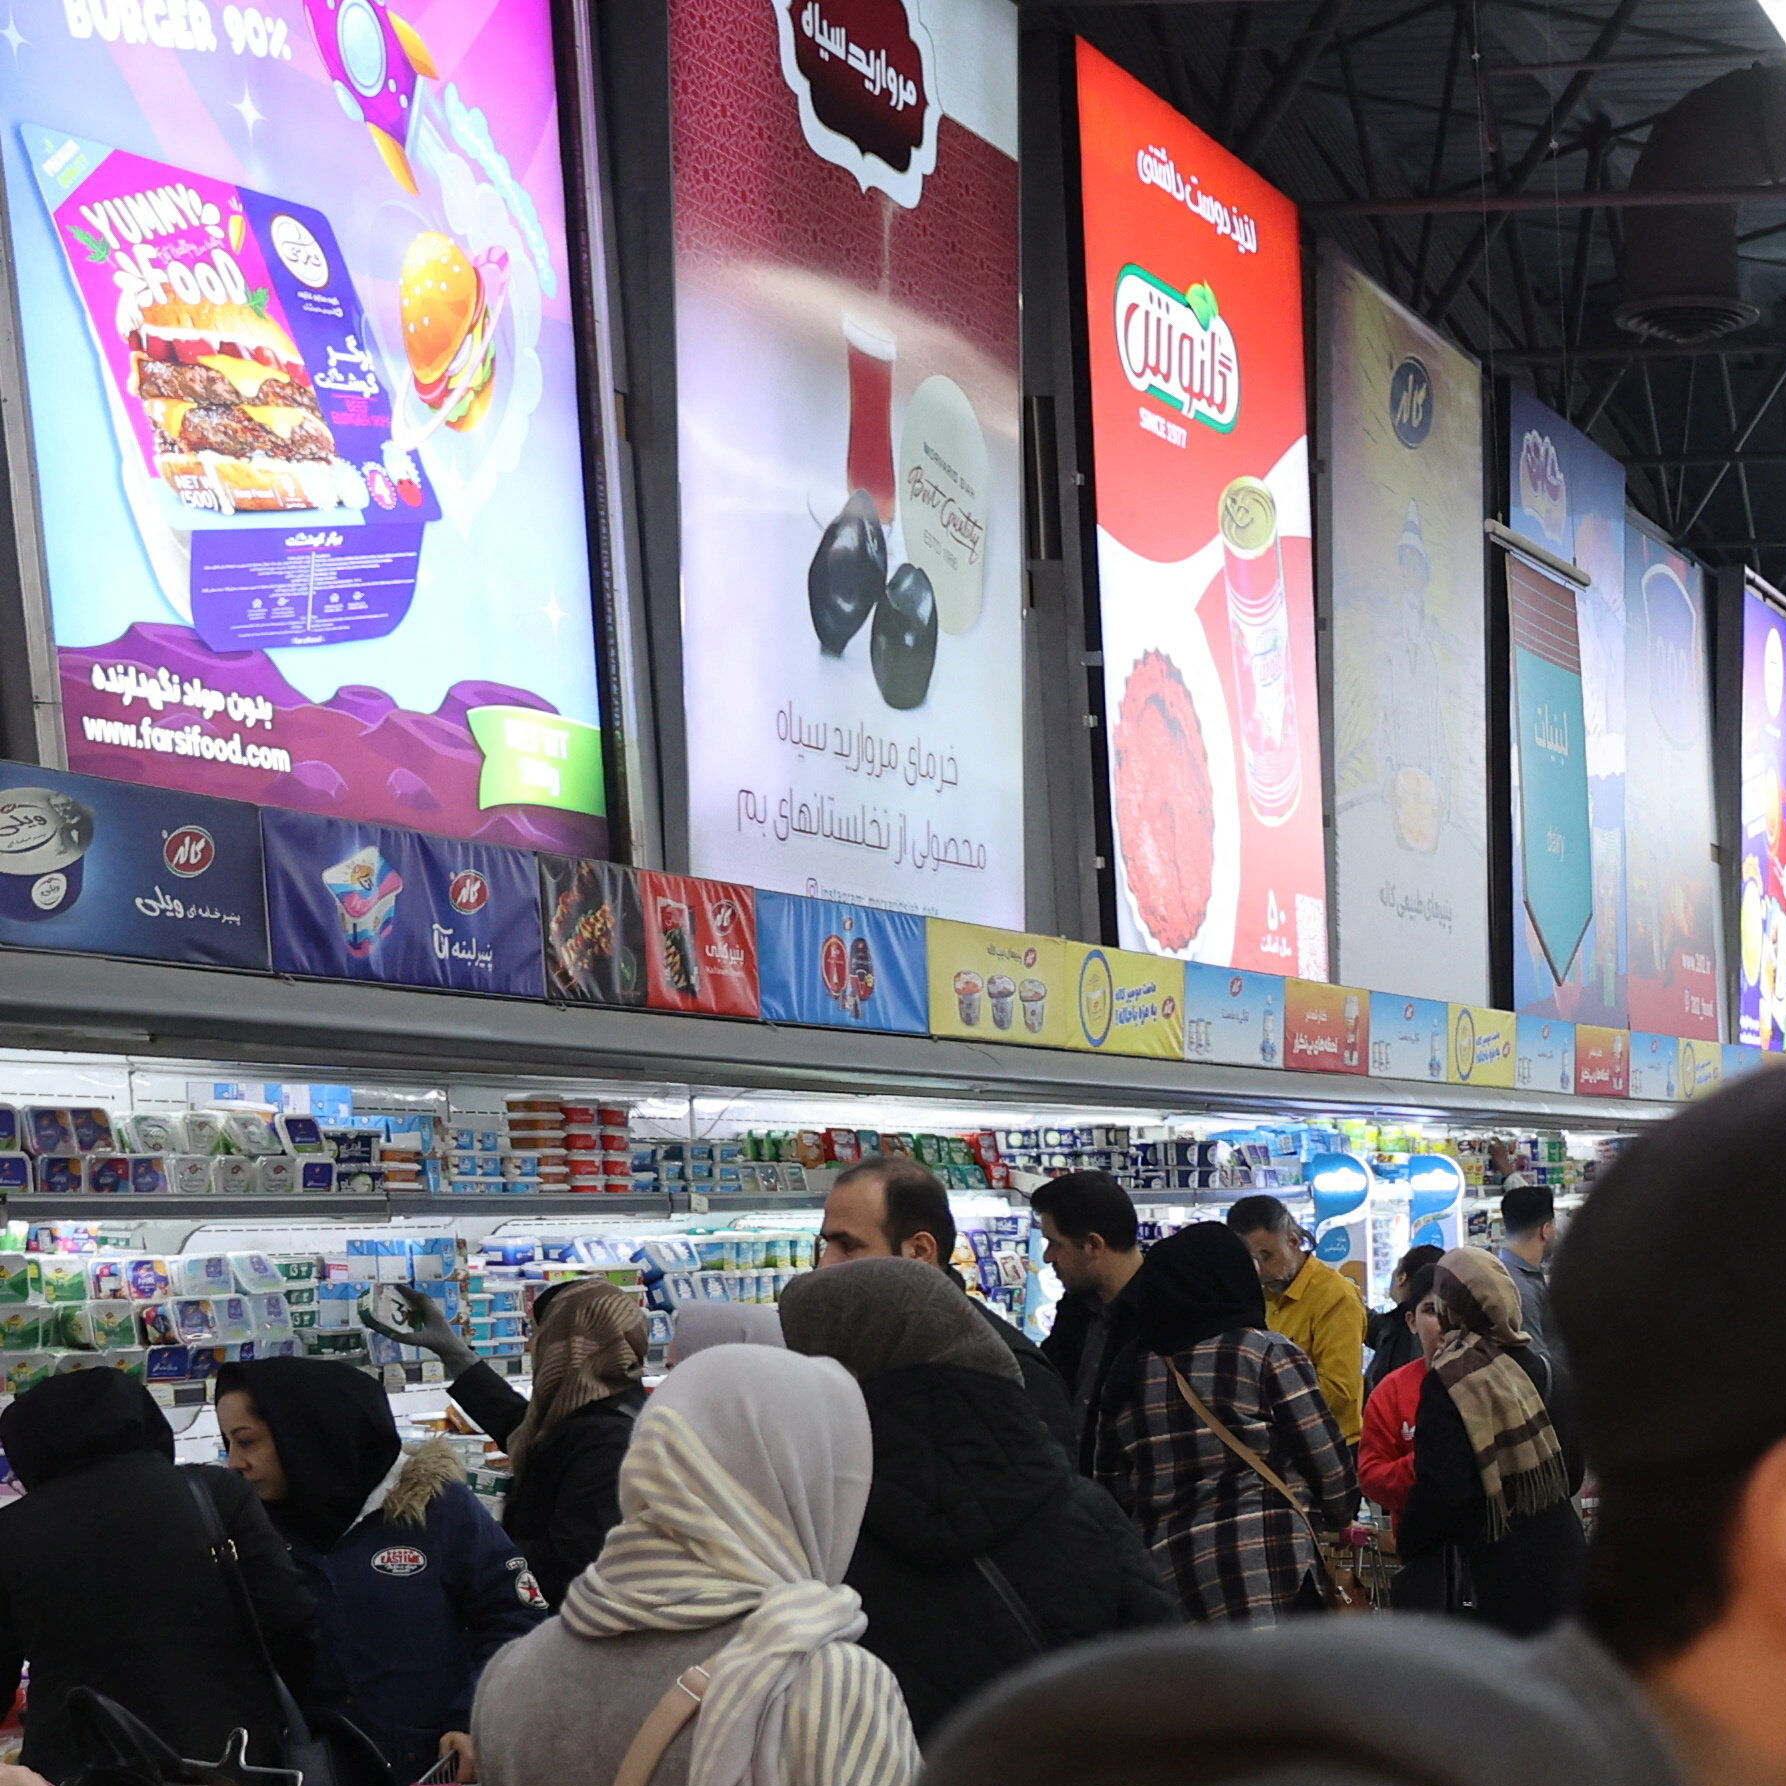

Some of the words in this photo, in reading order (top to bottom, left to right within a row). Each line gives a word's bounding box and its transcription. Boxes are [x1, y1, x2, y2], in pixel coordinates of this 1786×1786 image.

[66, 0, 217, 52] BURGER
[223, 6, 291, 60] 90%
[801, 1, 846, 62] سیاه
[847, 41, 917, 111] مروارید
[80, 183, 203, 250] YUMMY
[1185, 175, 1231, 236] دوست
[133, 243, 248, 305] FOOD
[907, 465, 948, 508] Best
[91, 663, 182, 711] نگهدارنده
[182, 678, 225, 720] مواد
[226, 692, 274, 730] بدون
[82, 716, 292, 773] www.farsifood.com
[776, 700, 828, 761] سیاه
[833, 720, 898, 778] مروارید
[1533, 704, 1570, 765] لبنیات
[904, 735, 959, 794] خرمای
[737, 788, 768, 839] بم
[773, 787, 891, 850] نخلستانهای
[893, 812, 908, 865] از
[912, 818, 987, 872] محصولی
[1546, 828, 1566, 862] dairy
[134, 885, 185, 920] ویلی
[1266, 888, 1288, 932] ۵۰
